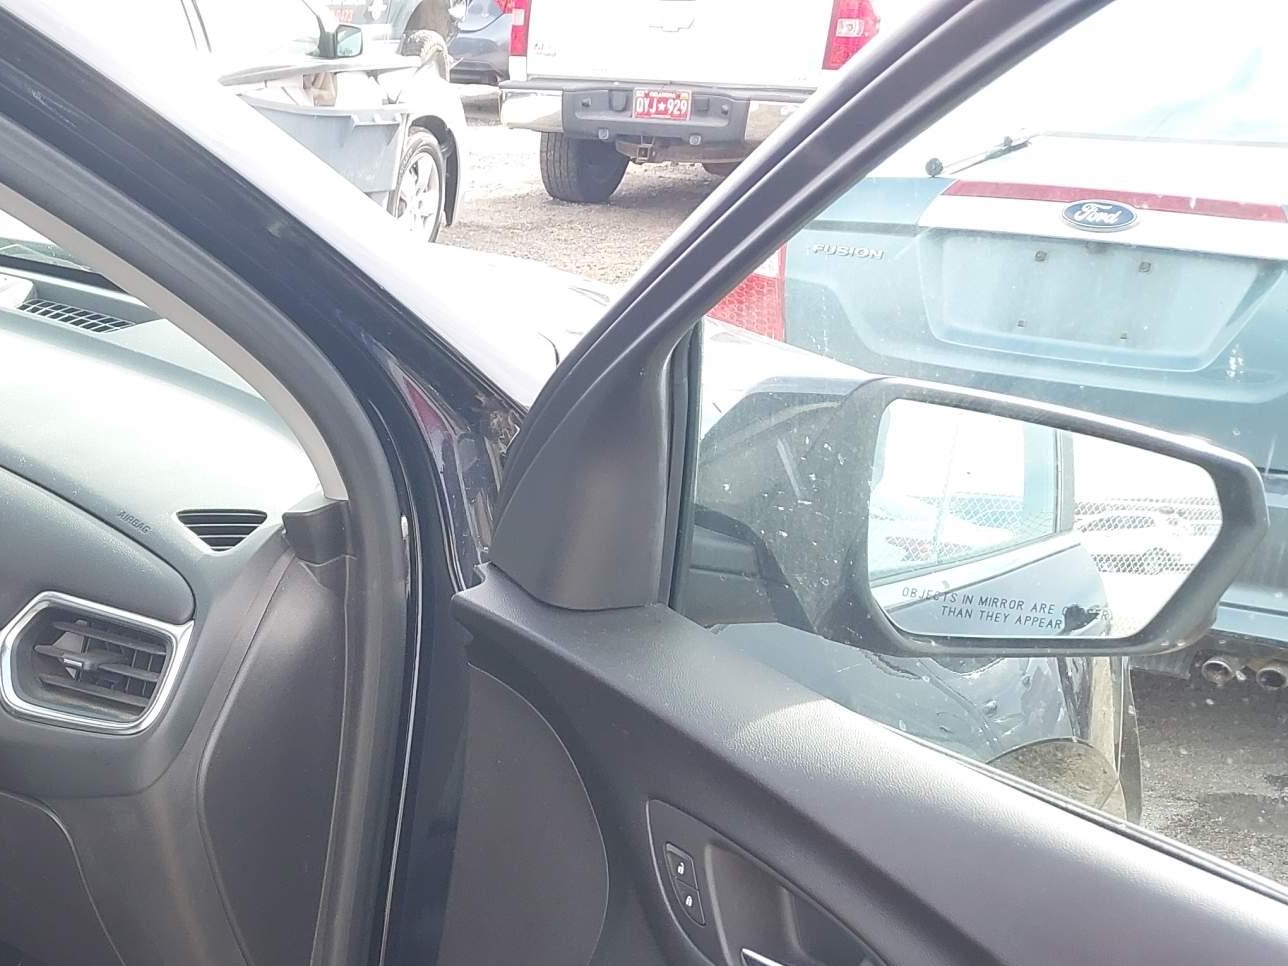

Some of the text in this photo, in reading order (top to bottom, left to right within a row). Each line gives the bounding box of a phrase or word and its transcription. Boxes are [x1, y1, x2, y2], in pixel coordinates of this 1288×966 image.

[1073, 203, 1123, 225] Ford
[812, 242, 885, 261] FUSION
[118, 509, 153, 535] AIRBAG
[901, 586, 959, 604] OBJECTS
[961, 594, 974, 606] IN
[978, 595, 1025, 611] MIRROR
[1031, 602, 1056, 615] ARE
[941, 605, 1063, 630] THAN THEY APPEAR
